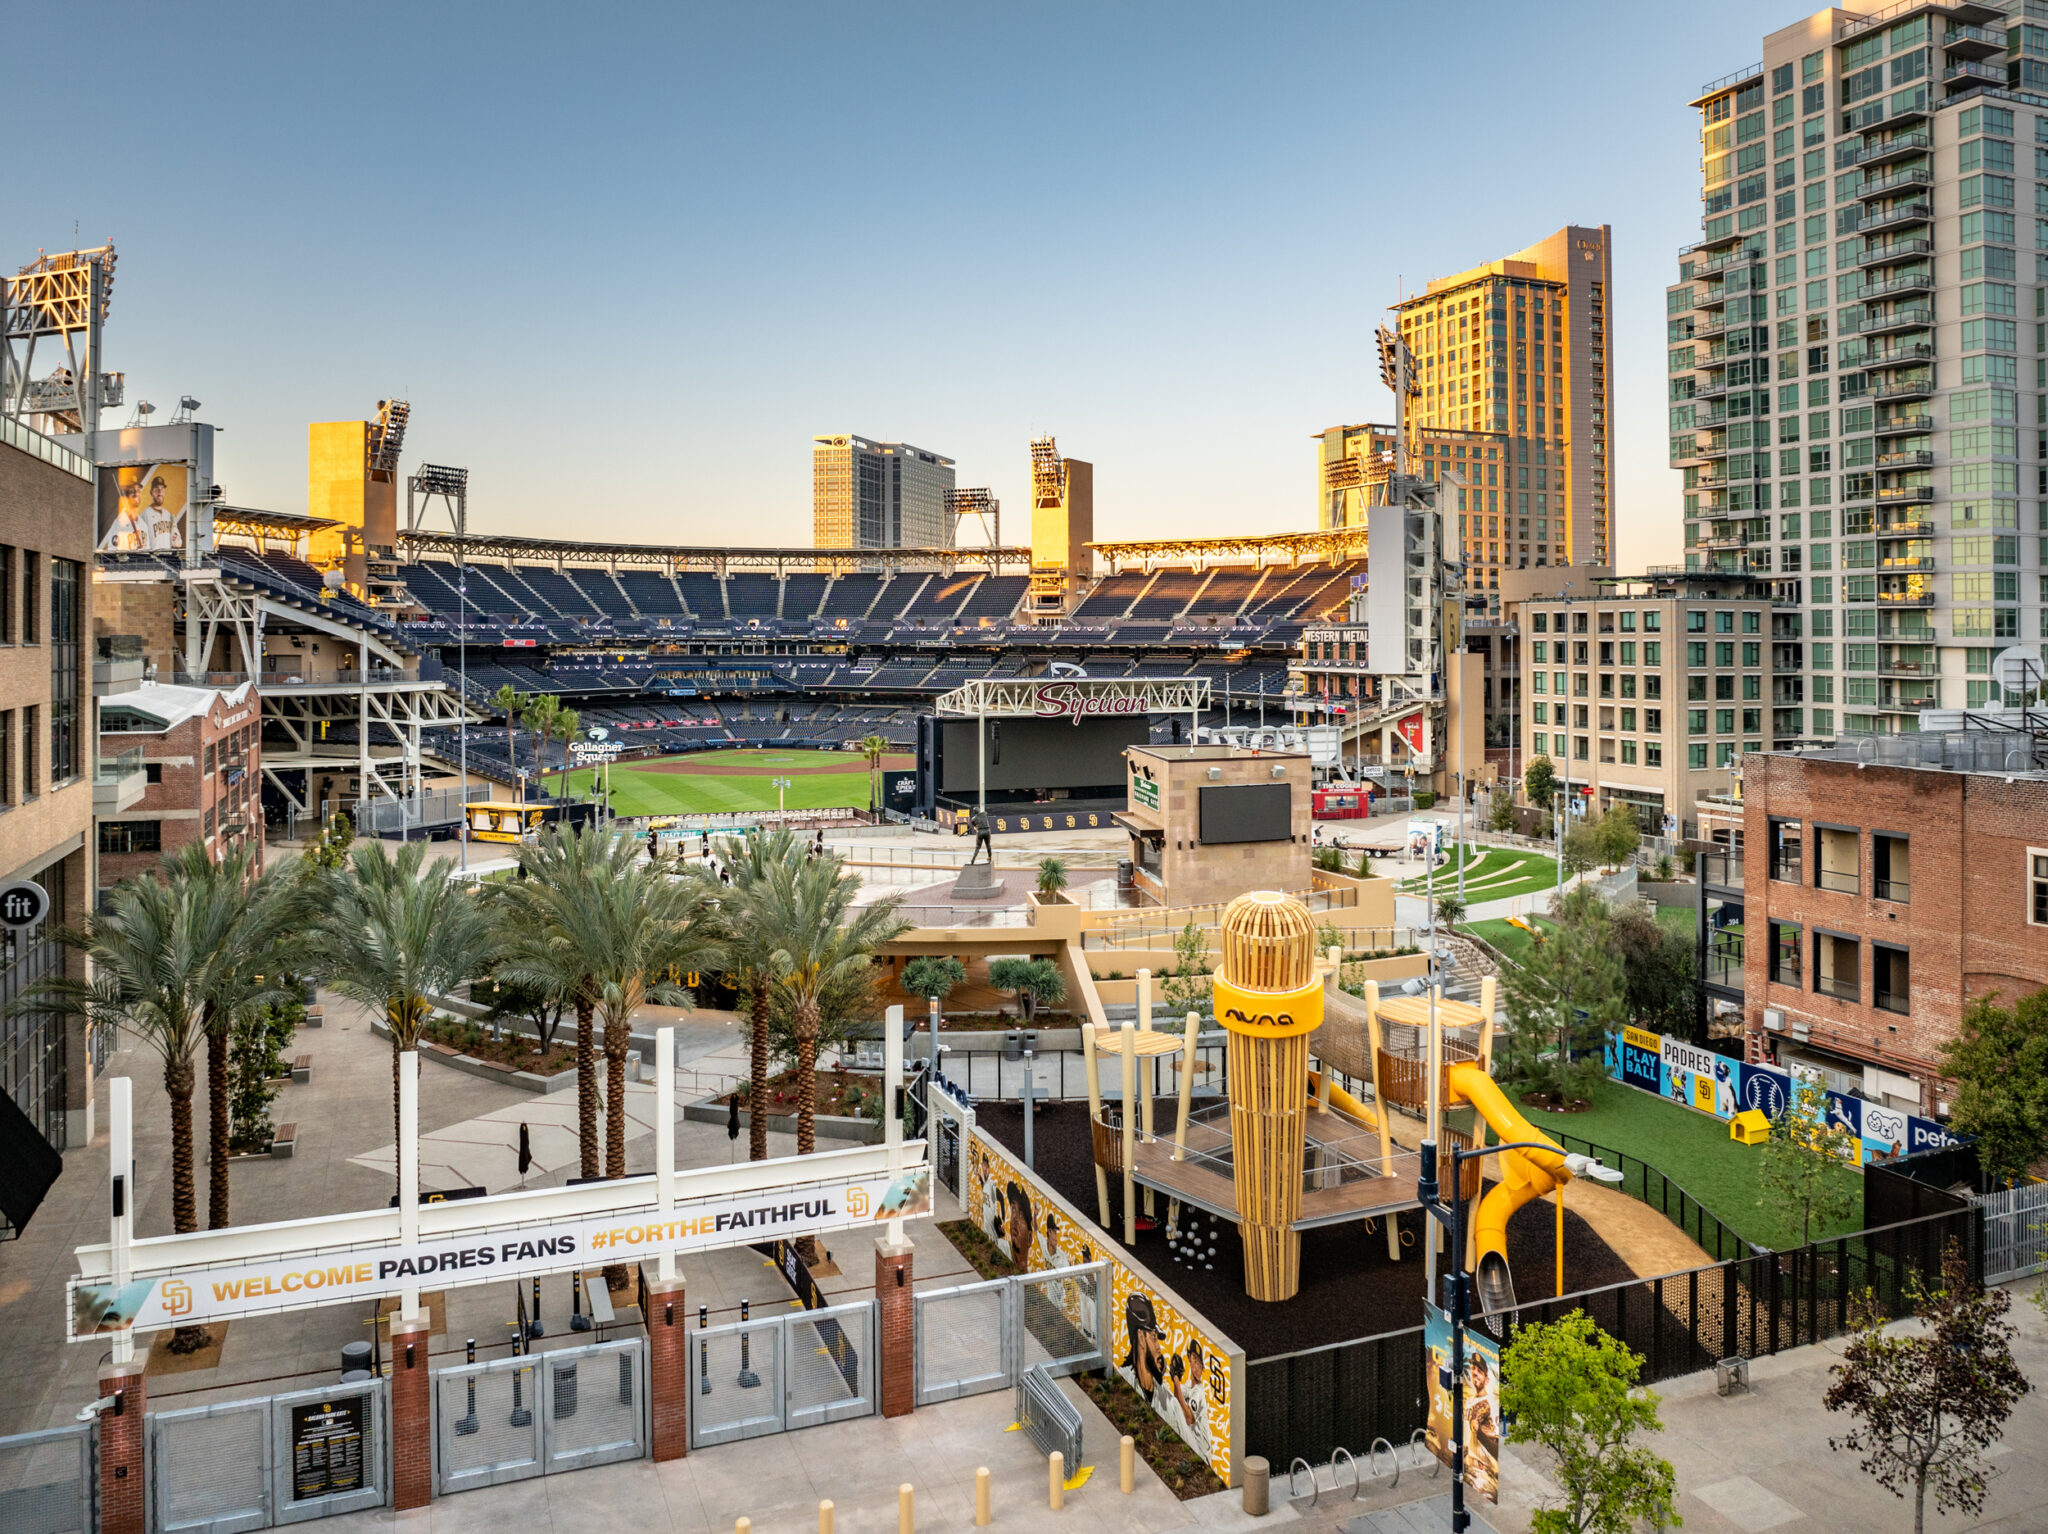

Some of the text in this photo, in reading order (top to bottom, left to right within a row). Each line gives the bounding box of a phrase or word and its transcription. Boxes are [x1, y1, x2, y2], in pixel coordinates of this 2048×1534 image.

[1304, 631, 1369, 642] WESTERN METAL
[1035, 681, 1149, 726] Sycuan
[569, 741, 623, 753] Gallagher
[5, 894, 31, 918] fit
[1626, 1030, 1657, 1049] SAN DIEGO
[1626, 1047, 1657, 1067] PLAY
[1664, 1043, 1711, 1074] PADRES
[1626, 1061, 1657, 1081] BALL
[212, 1262, 373, 1302] WELCOME
[379, 1246, 495, 1280] PADRES
[502, 1235, 575, 1262] FANS
[591, 1199, 836, 1250] #FORTHEFAITHFUL
